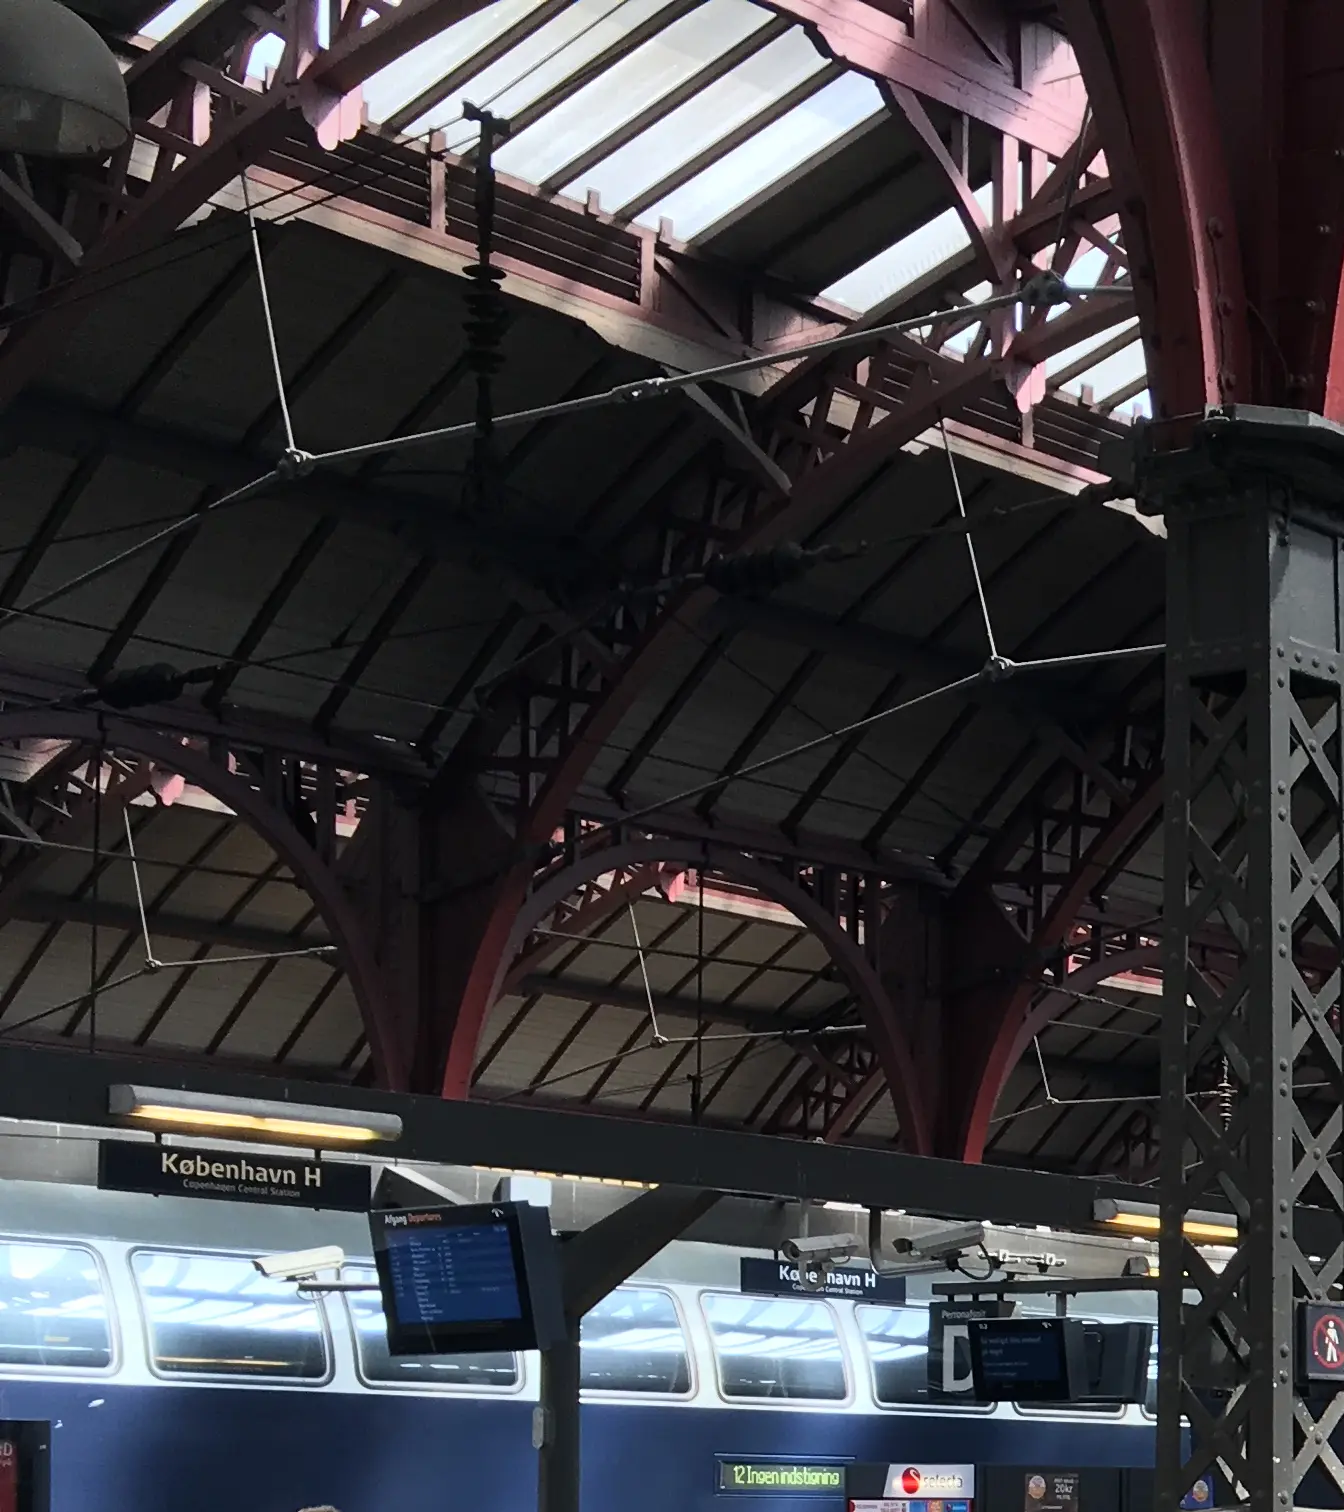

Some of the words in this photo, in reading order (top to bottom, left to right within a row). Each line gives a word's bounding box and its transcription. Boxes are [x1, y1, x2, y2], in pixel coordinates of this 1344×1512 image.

[161, 1152, 297, 1185] København
[304, 1166, 321, 1188] H
[183, 1178, 236, 1193] Copenhagen
[238, 1183, 268, 1195] Central
[270, 1187, 301, 1198] Station
[865, 1273, 876, 1288] H
[733, 1465, 746, 1484] 12
[746, 1465, 780, 1485] Ingen
[780, 1466, 840, 1486] indstigning
[923, 1473, 963, 1489] selecta
